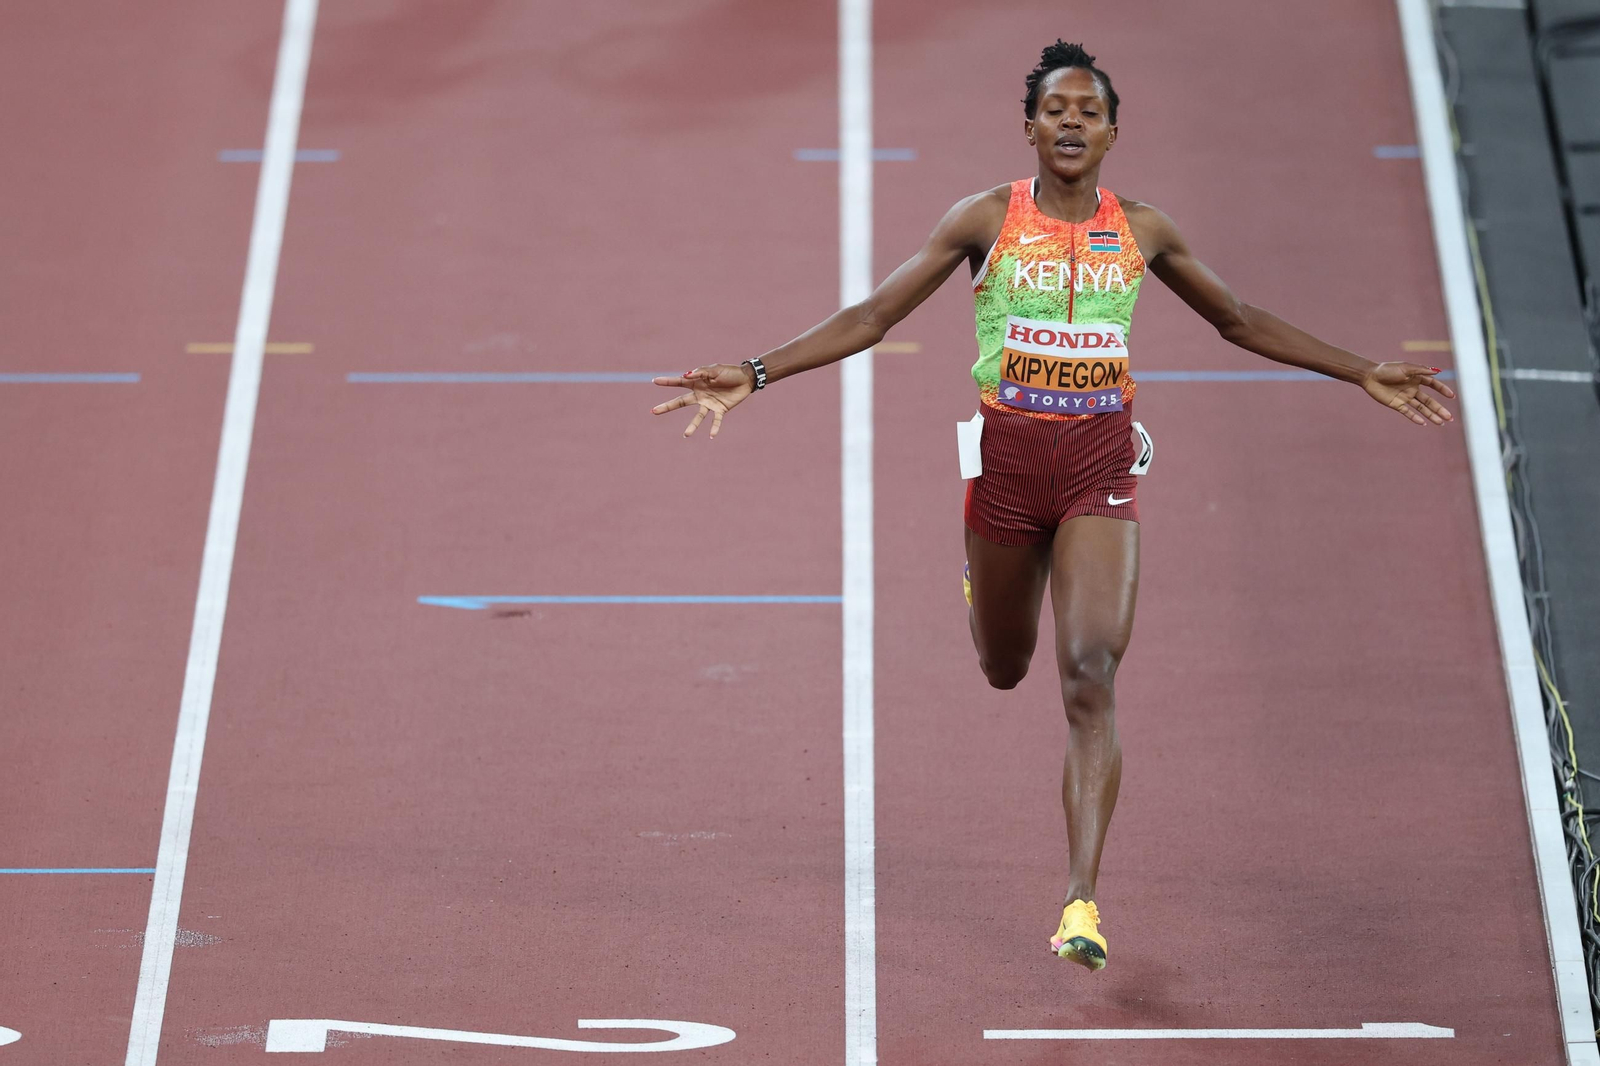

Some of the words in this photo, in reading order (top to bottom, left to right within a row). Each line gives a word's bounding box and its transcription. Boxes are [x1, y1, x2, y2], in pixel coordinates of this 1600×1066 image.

[1014, 259, 1127, 293] KENYA
[1007, 324, 1124, 349] HONDA
[1006, 353, 1123, 389] KIPYEGON
[1099, 394, 1117, 407] 25
[266, 1019, 736, 1053] 2
